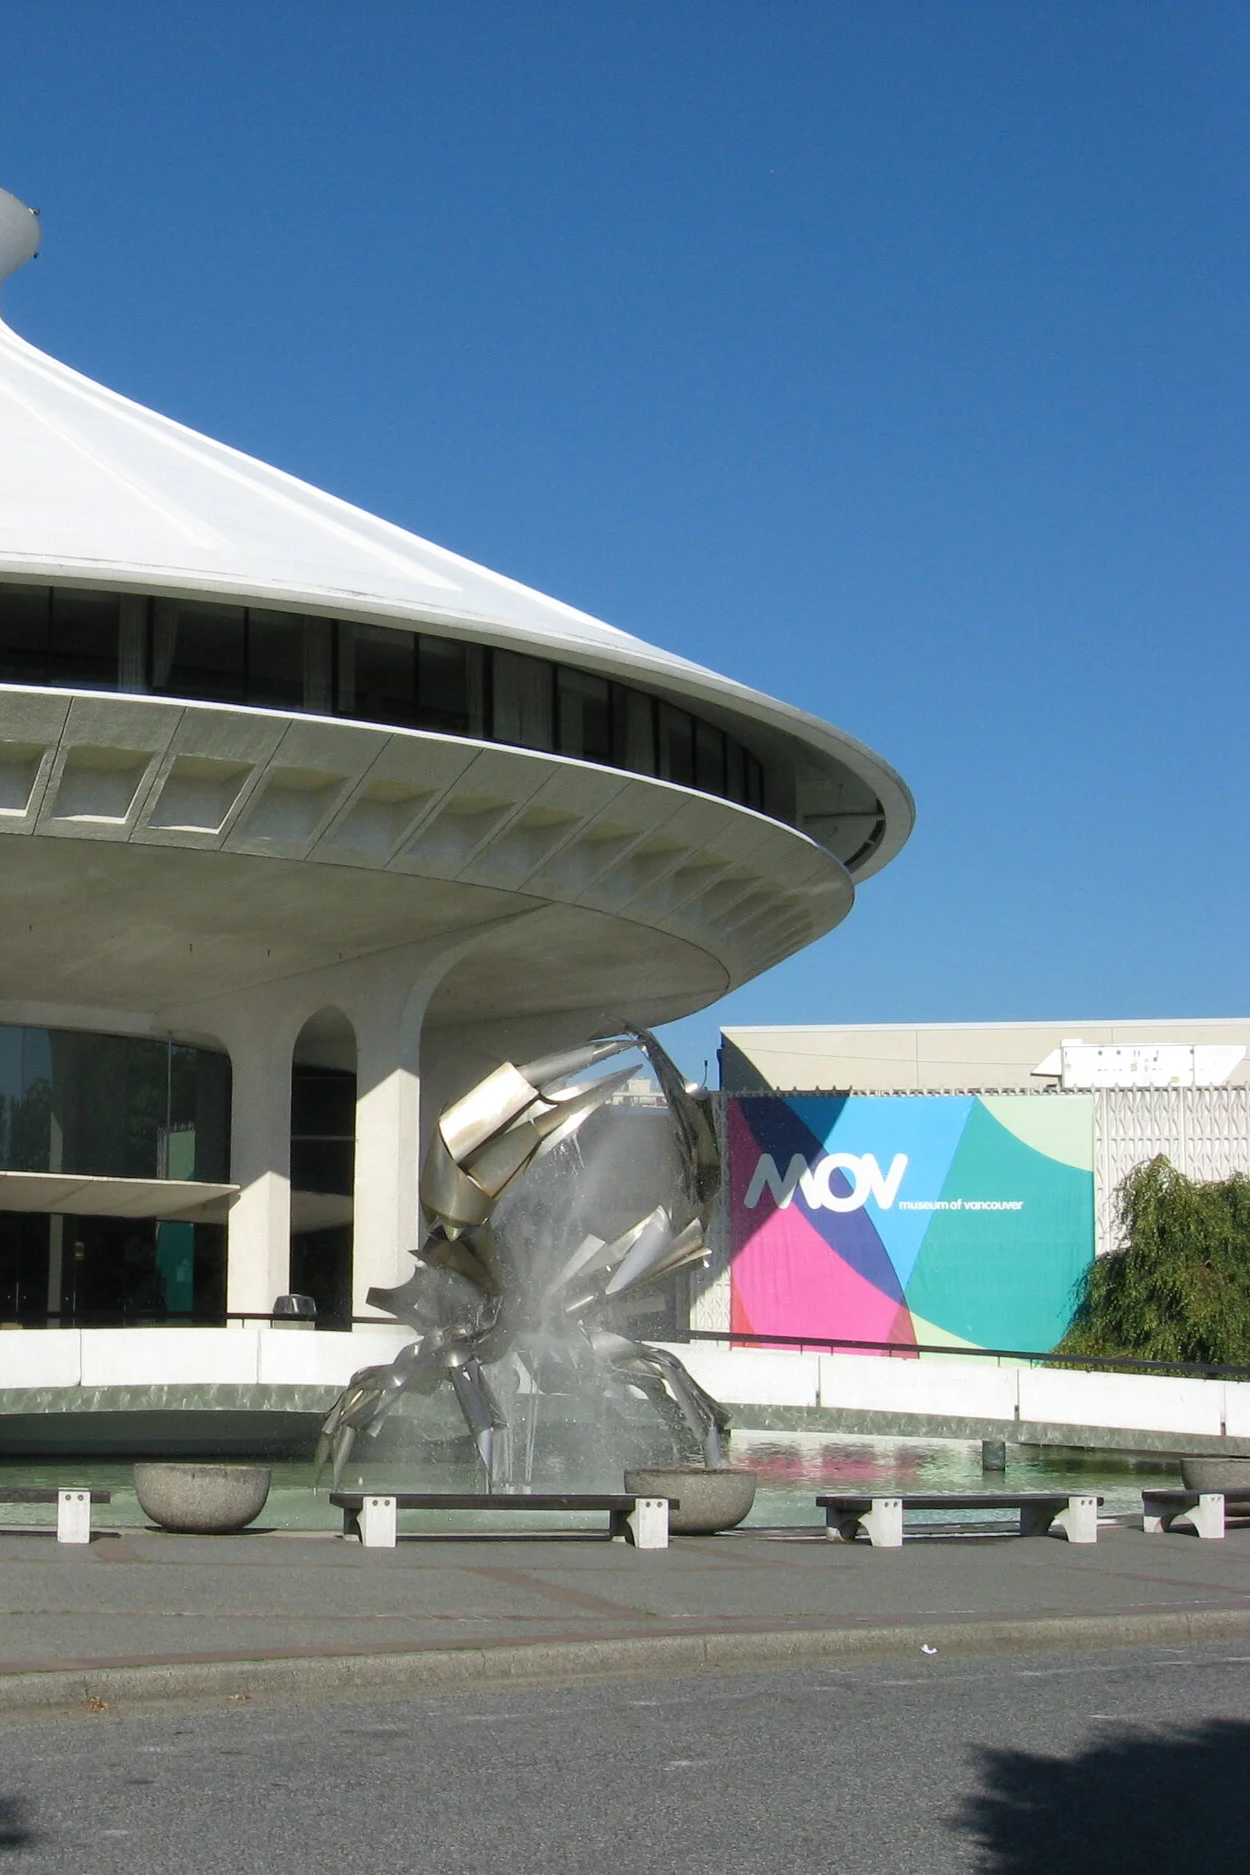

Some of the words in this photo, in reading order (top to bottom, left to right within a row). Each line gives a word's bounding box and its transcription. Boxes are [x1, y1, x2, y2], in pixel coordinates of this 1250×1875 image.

[744, 1153, 908, 1212] MOV
[899, 1200, 948, 1210] museum
[949, 1198, 962, 1210] of
[963, 1200, 1024, 1210] vancouver
